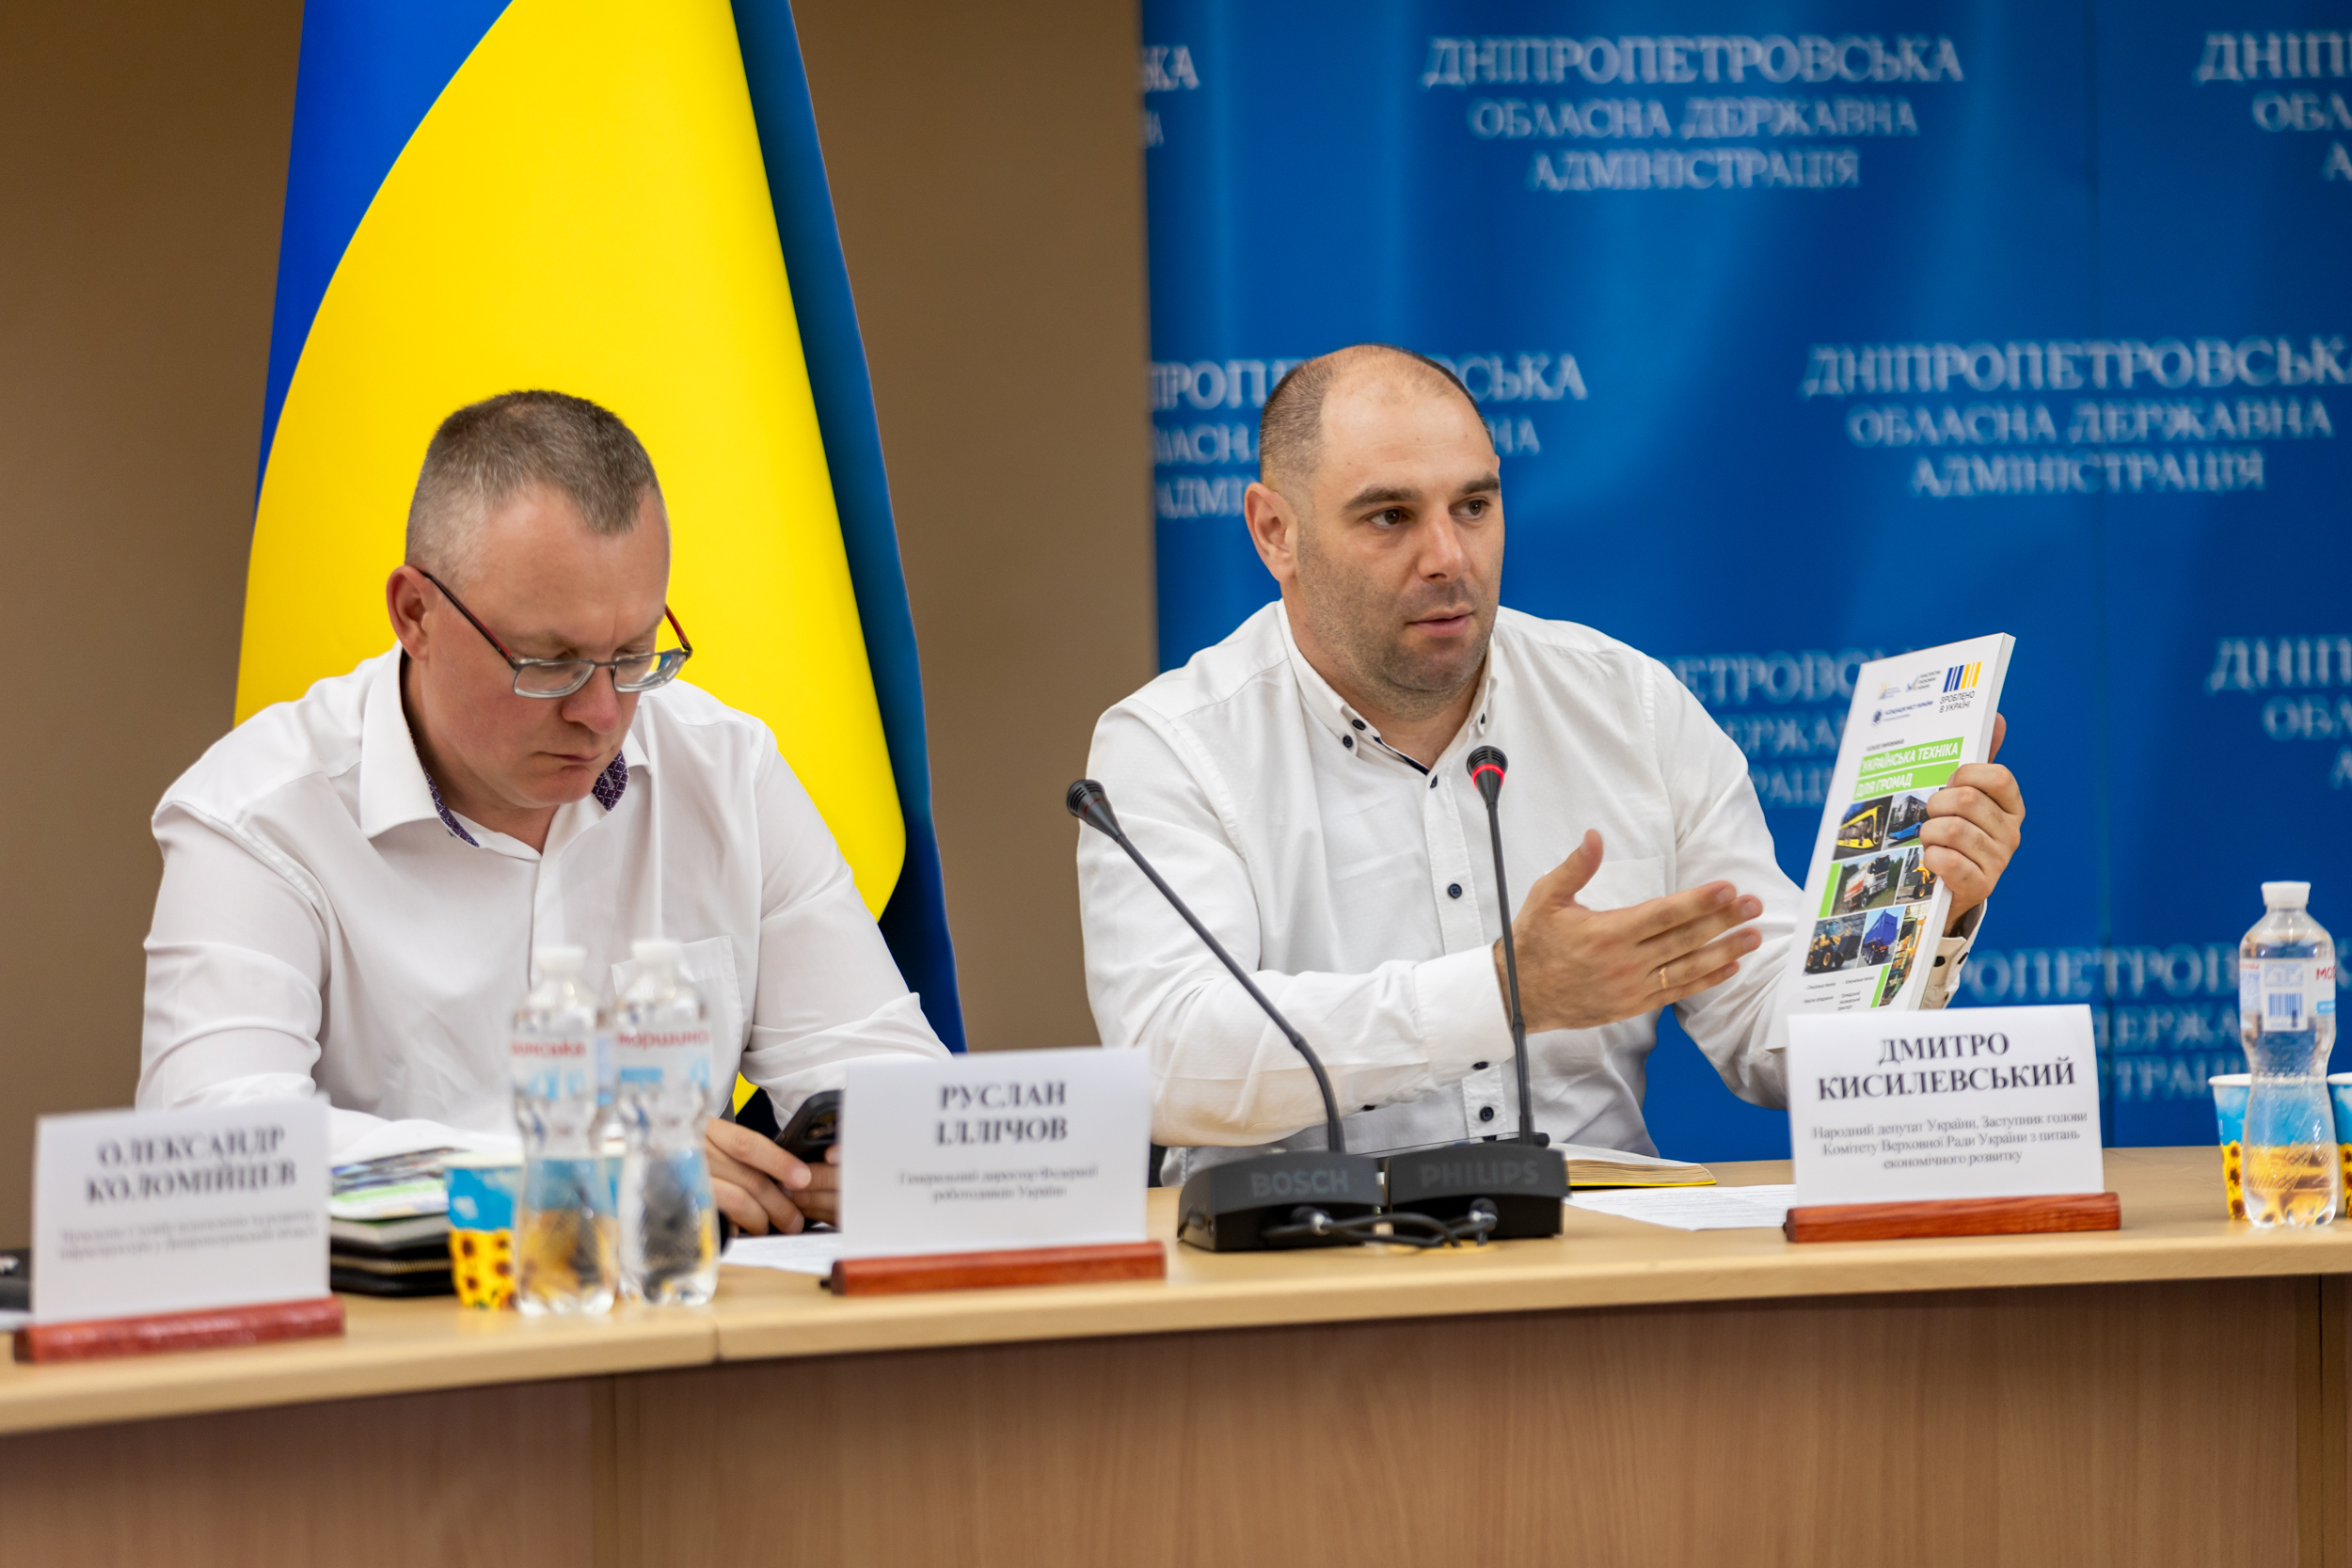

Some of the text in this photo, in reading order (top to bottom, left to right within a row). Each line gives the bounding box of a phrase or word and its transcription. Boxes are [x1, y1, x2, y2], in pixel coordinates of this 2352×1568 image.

[1422, 35, 1964, 89] ДНІПРОПЕТРОВСЬКА
[2194, 31, 2352, 87] ДНІП
[1470, 95, 1919, 139] ОБЛАСНА ДЕРЖАВНА
[1531, 148, 1861, 193] АДМІНІСТРАЦІЯ
[1802, 335, 2352, 398] ДНІПРОПЕТРОВСЬК
[1847, 397, 2334, 448] ОБЛАСНА ДЕРЖАВНА
[1910, 448, 2265, 499] АДМІНІСТРАЦІЯ
[1939, 690, 1976, 705] ЗРОБЛЕНО
[1945, 700, 1971, 713] УКРАЇНІ
[1862, 742, 1959, 773] УКРАЇНСЬКА ТЕХНІКА
[1854, 772, 1914, 799] ДЛЯ ГРОМАД
[1879, 1033, 2010, 1066] ДМИТРО
[1817, 1057, 2076, 1101] КИСИЛЕВСЬКИЙ
[941, 1081, 1068, 1111] РУСЛАН
[936, 1116, 1069, 1146] ІЛЛІЧОВ
[1813, 1112, 2088, 1141] Народний депутат України, Заступник голови
[97, 1126, 286, 1166] ОЛЕКСАНДР
[1822, 1143, 1879, 1157] Комітету
[1882, 1138, 1944, 1153] Верховної
[1947, 1134, 1976, 1148] Ради
[1979, 1132, 2027, 1147] України
[2040, 1130, 2080, 1142] питань
[1421, 1161, 1540, 1189] PHILIPS
[1883, 1149, 2024, 1170] економічного розвитку
[1251, 1169, 1349, 1197] BOSCH
